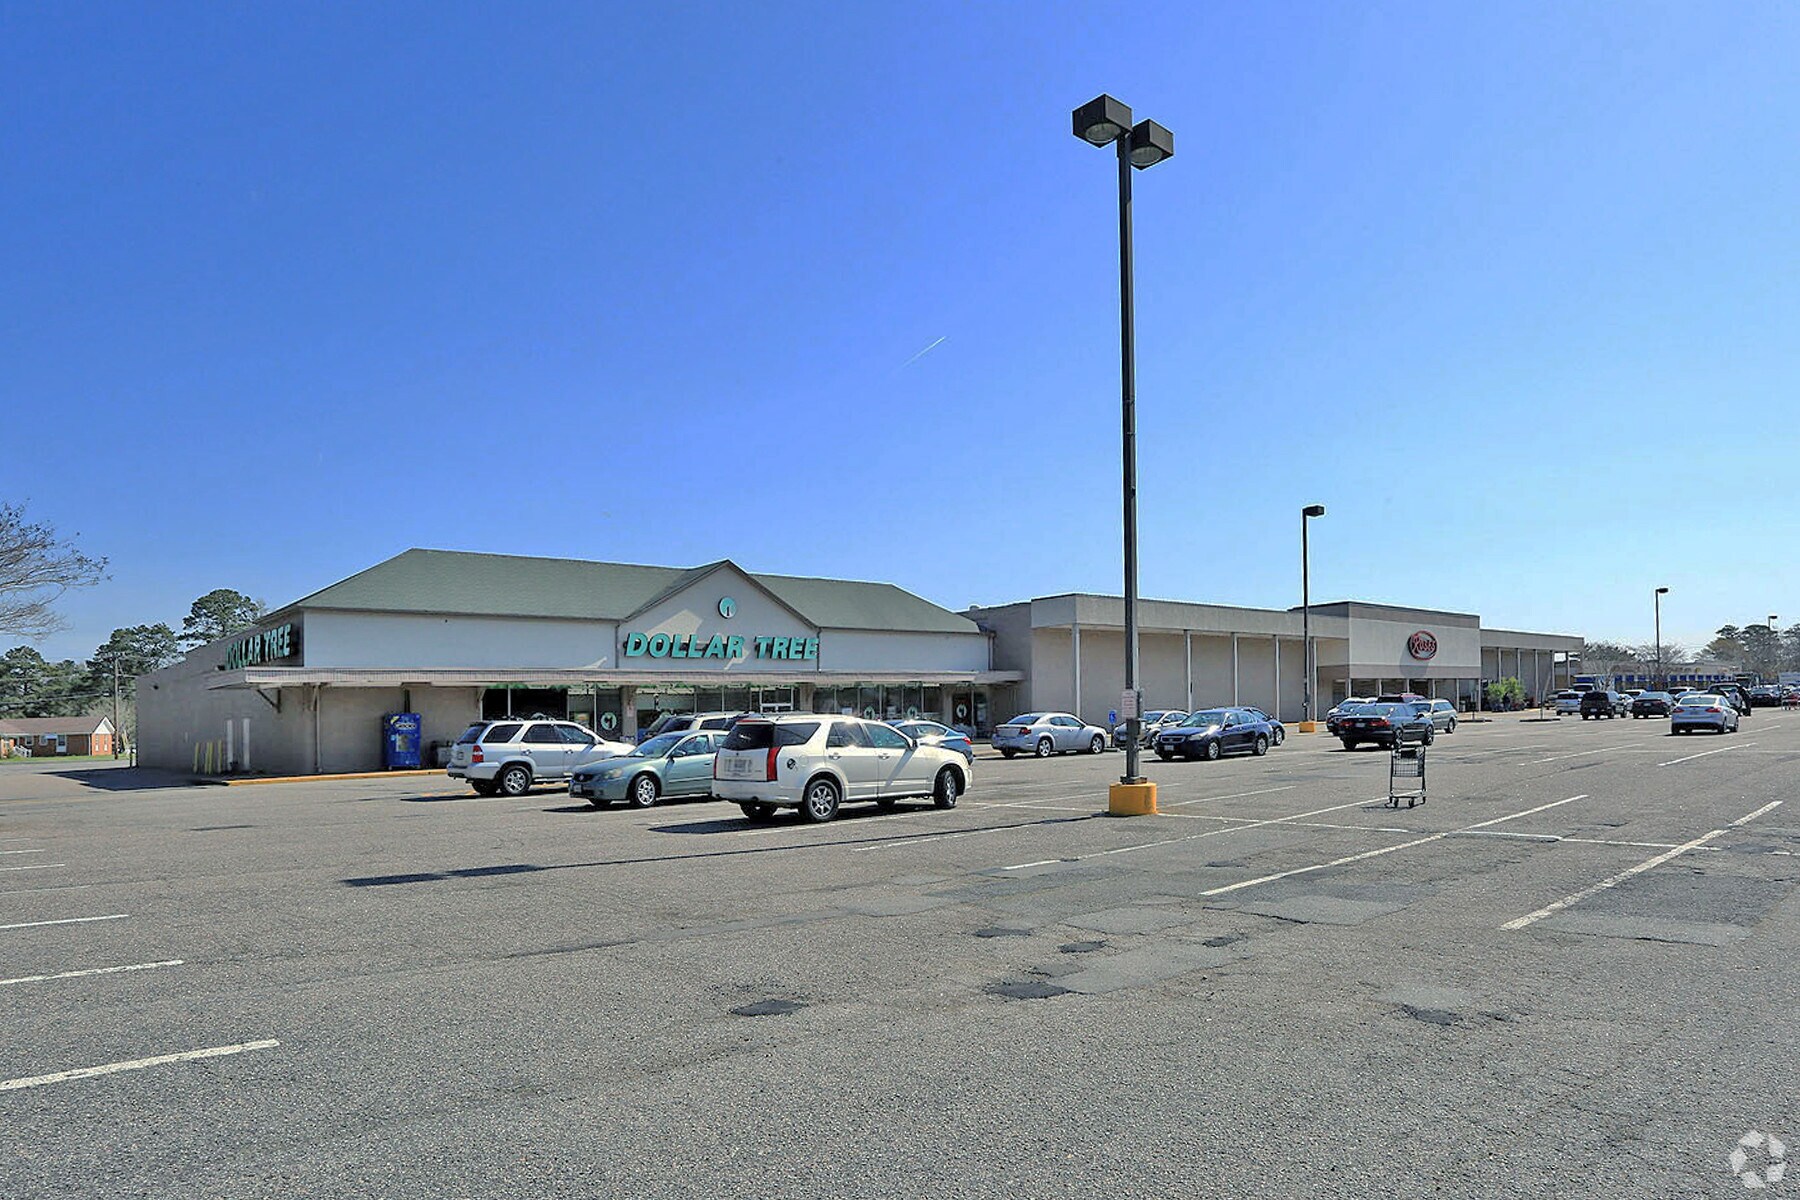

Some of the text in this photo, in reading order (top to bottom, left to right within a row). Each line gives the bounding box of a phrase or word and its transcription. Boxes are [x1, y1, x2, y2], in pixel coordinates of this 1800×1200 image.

[226, 623, 291, 670] DOLLAR TREE
[624, 632, 819, 660] DOLLAR TREE
